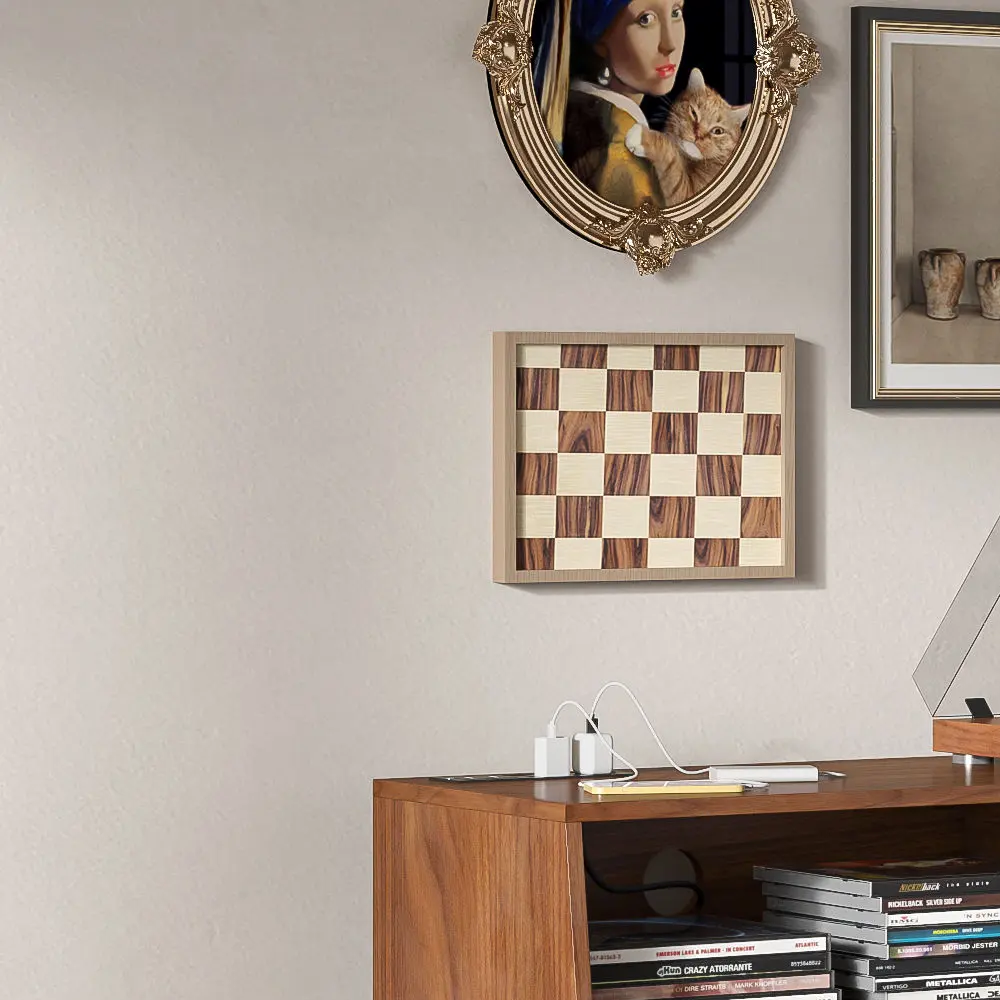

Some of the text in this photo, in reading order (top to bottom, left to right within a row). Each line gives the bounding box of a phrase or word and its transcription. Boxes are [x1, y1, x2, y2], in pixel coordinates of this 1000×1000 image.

[888, 900, 923, 908] NICKELBACK
[943, 942, 971, 950] MORBID
[972, 941, 998, 949] JESTER
[657, 949, 680, 957] EMERSON
[684, 963, 752, 974] CRAZY ATORRANTE
[701, 983, 725, 991] STRAITS
[735, 981, 752, 989] MARK
[754, 980, 787, 988] KNOPFLER
[926, 978, 978, 987] METALLICA
[937, 992, 980, 1000] METALLICA
